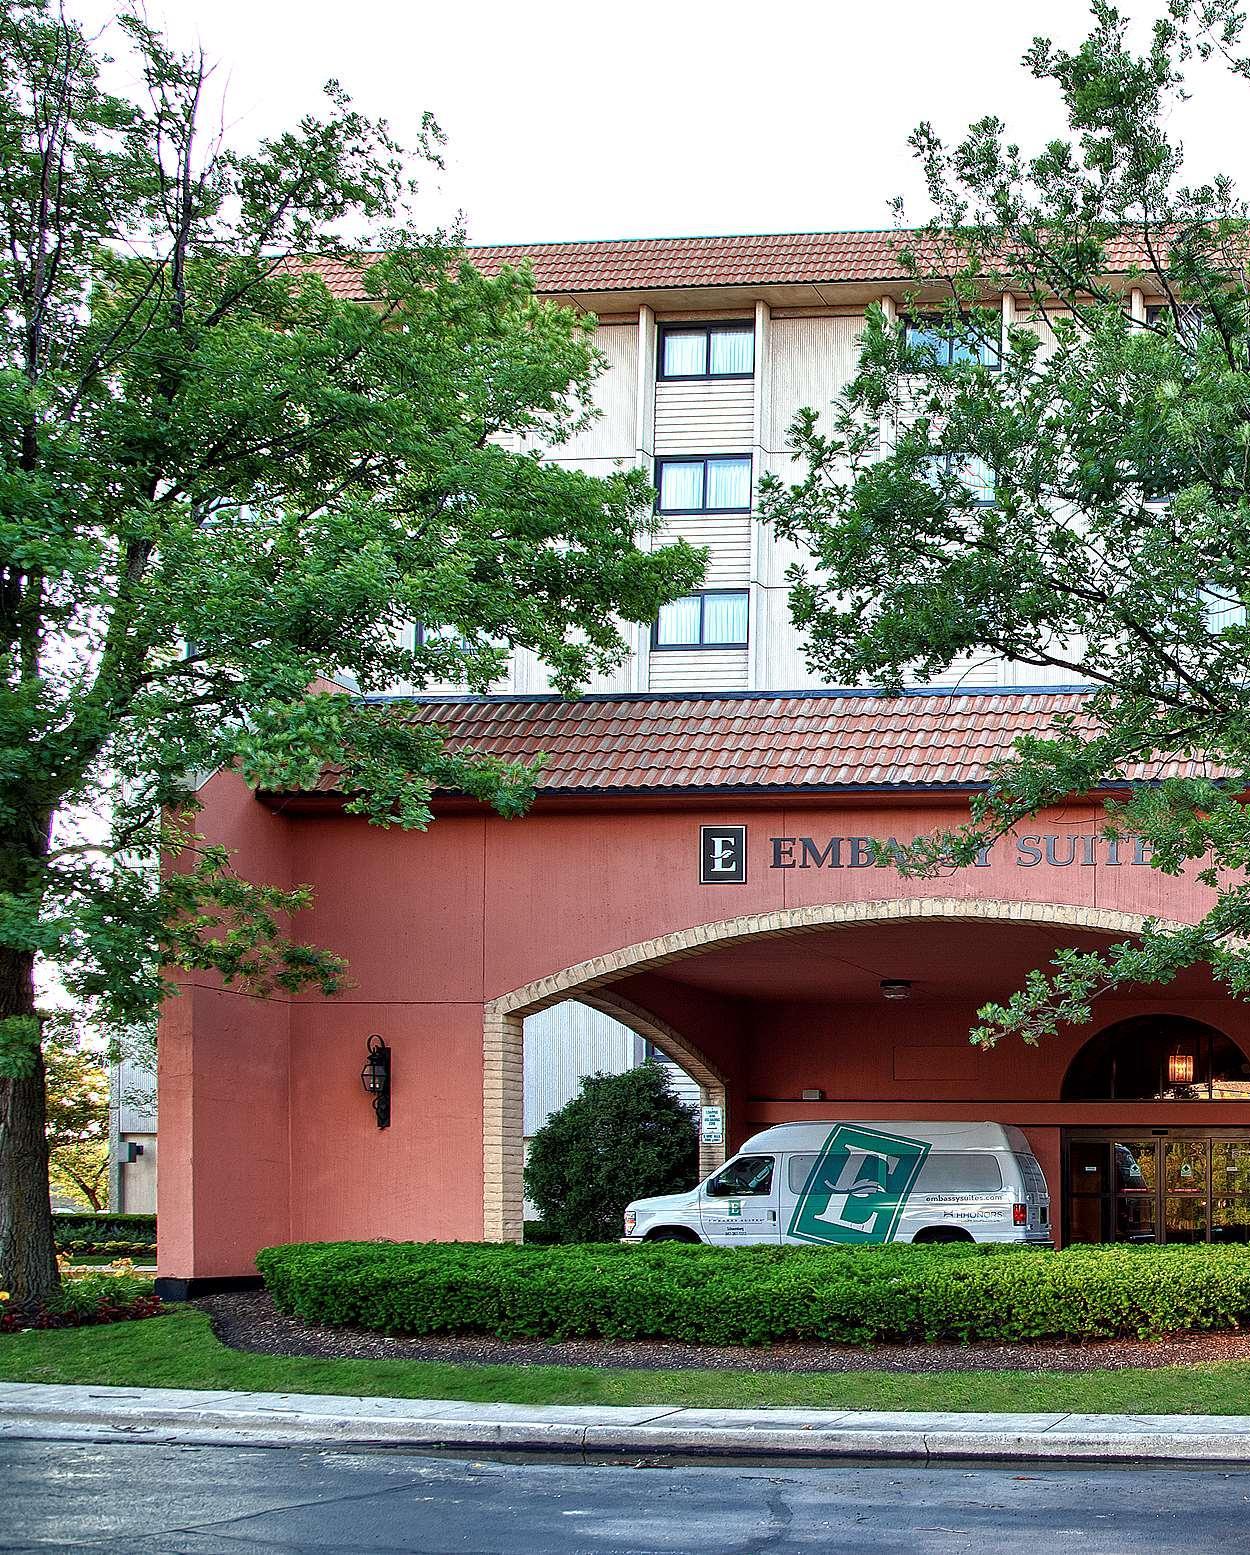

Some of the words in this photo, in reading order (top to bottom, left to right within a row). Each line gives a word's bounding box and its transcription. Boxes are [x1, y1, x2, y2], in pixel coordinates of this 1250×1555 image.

[710, 837, 736, 871] E
[1015, 834, 1185, 867] SUITE
[813, 1143, 901, 1234] E
[925, 1194, 1003, 1203] embassysuites.com
